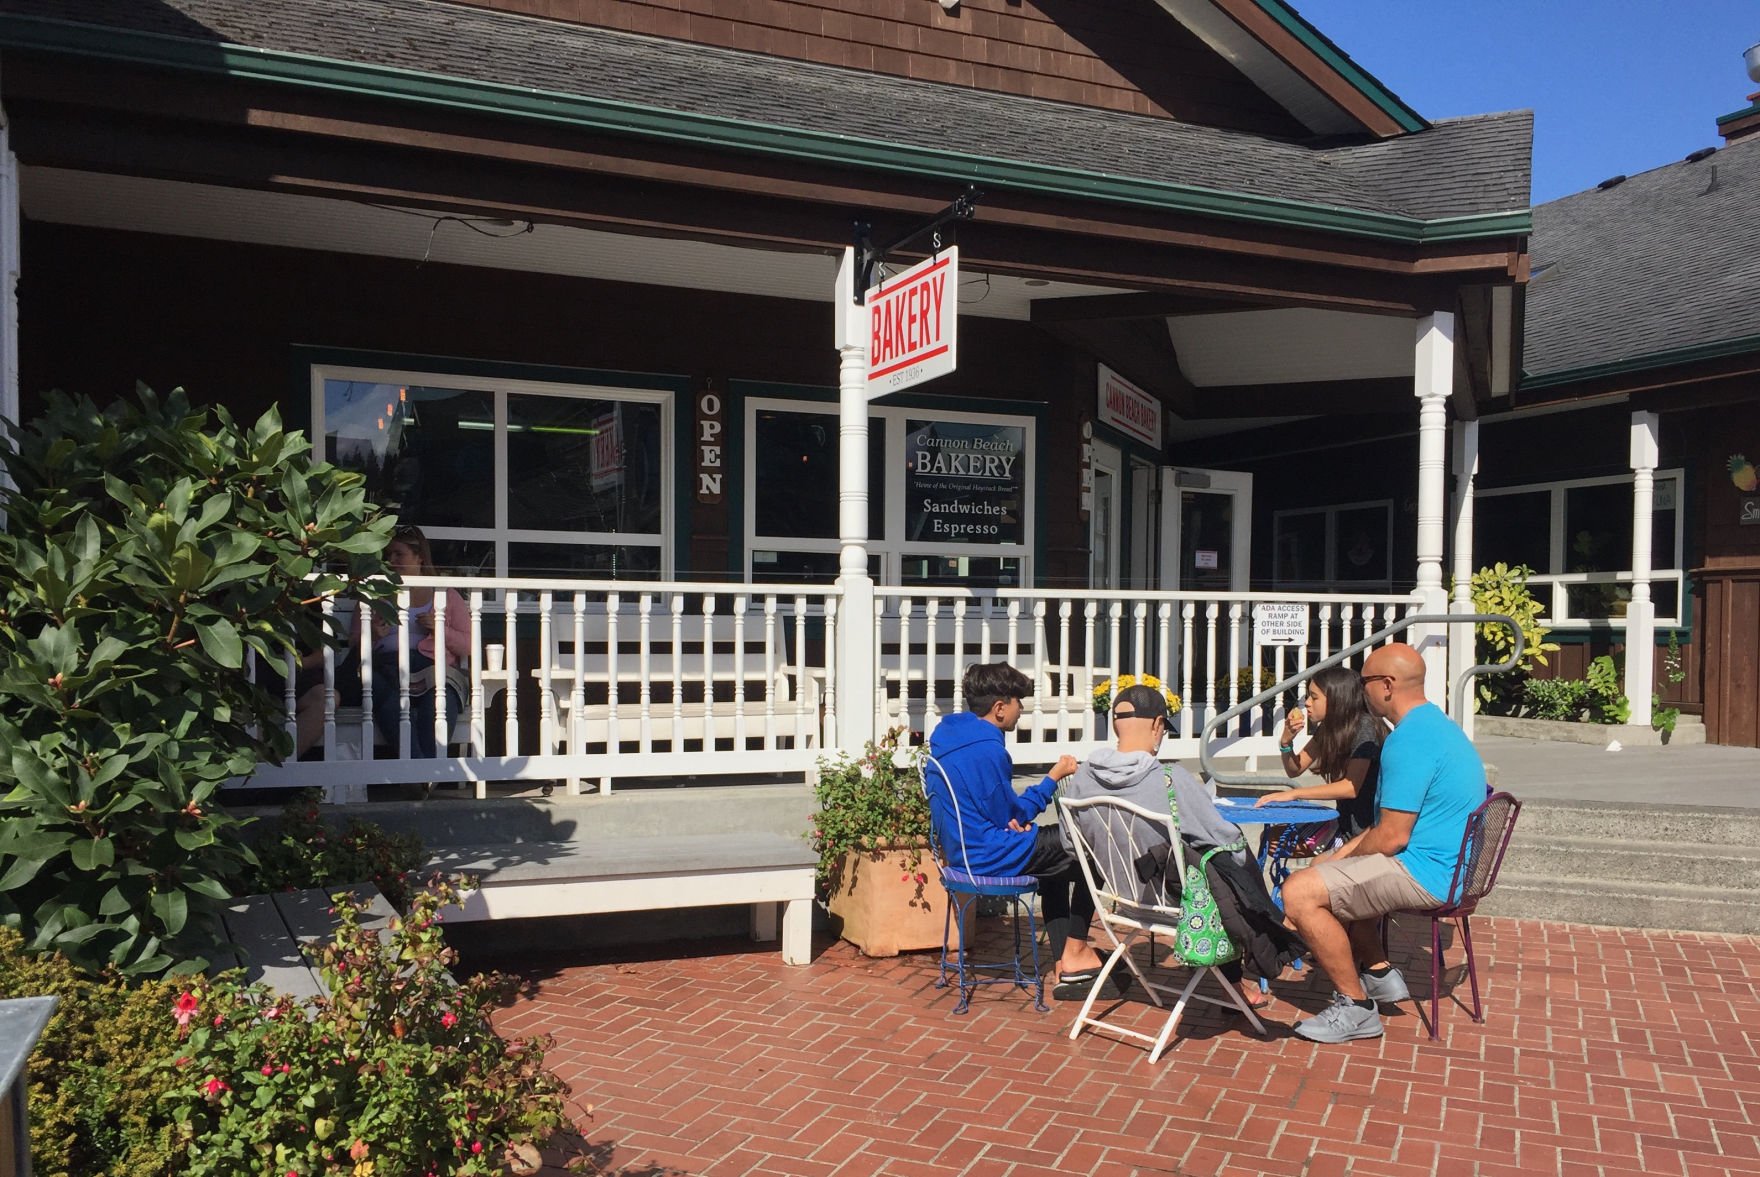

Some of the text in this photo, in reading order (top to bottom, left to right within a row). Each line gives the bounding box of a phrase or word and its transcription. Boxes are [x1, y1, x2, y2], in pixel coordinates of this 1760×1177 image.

[872, 272, 945, 367] BAKERY
[1126, 395, 1141, 425] BEACH
[700, 394, 722, 494] OPEN
[917, 434, 1013, 452] Cannon Beach
[915, 451, 1015, 477] BAKERY
[923, 498, 1007, 515] Sandwiches
[933, 519, 998, 537] Espresso
